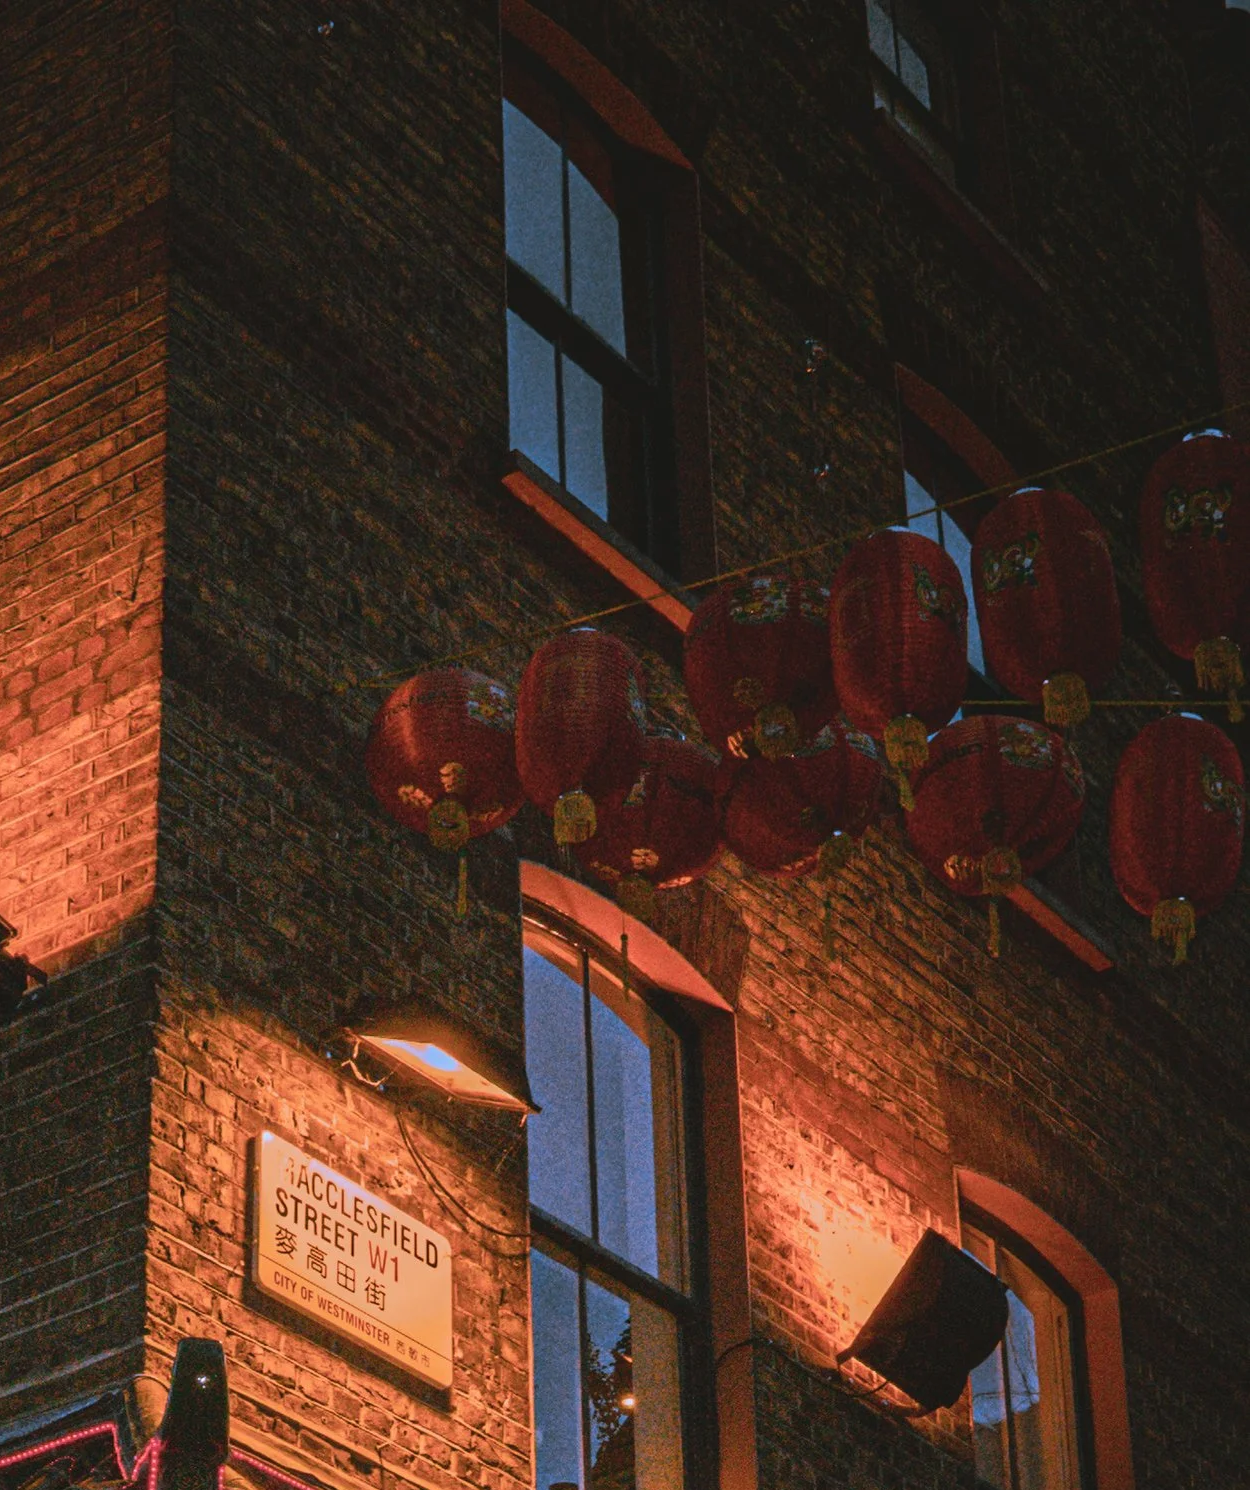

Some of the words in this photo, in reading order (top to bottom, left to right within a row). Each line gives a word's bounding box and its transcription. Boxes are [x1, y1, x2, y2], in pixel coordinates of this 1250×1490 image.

[275, 1188, 359, 1257] STREET
[369, 1240, 399, 1282] W1
[273, 1271, 297, 1293] CITY
[301, 1286, 314, 1301] OF
[317, 1295, 390, 1347] WESTMINSTER
